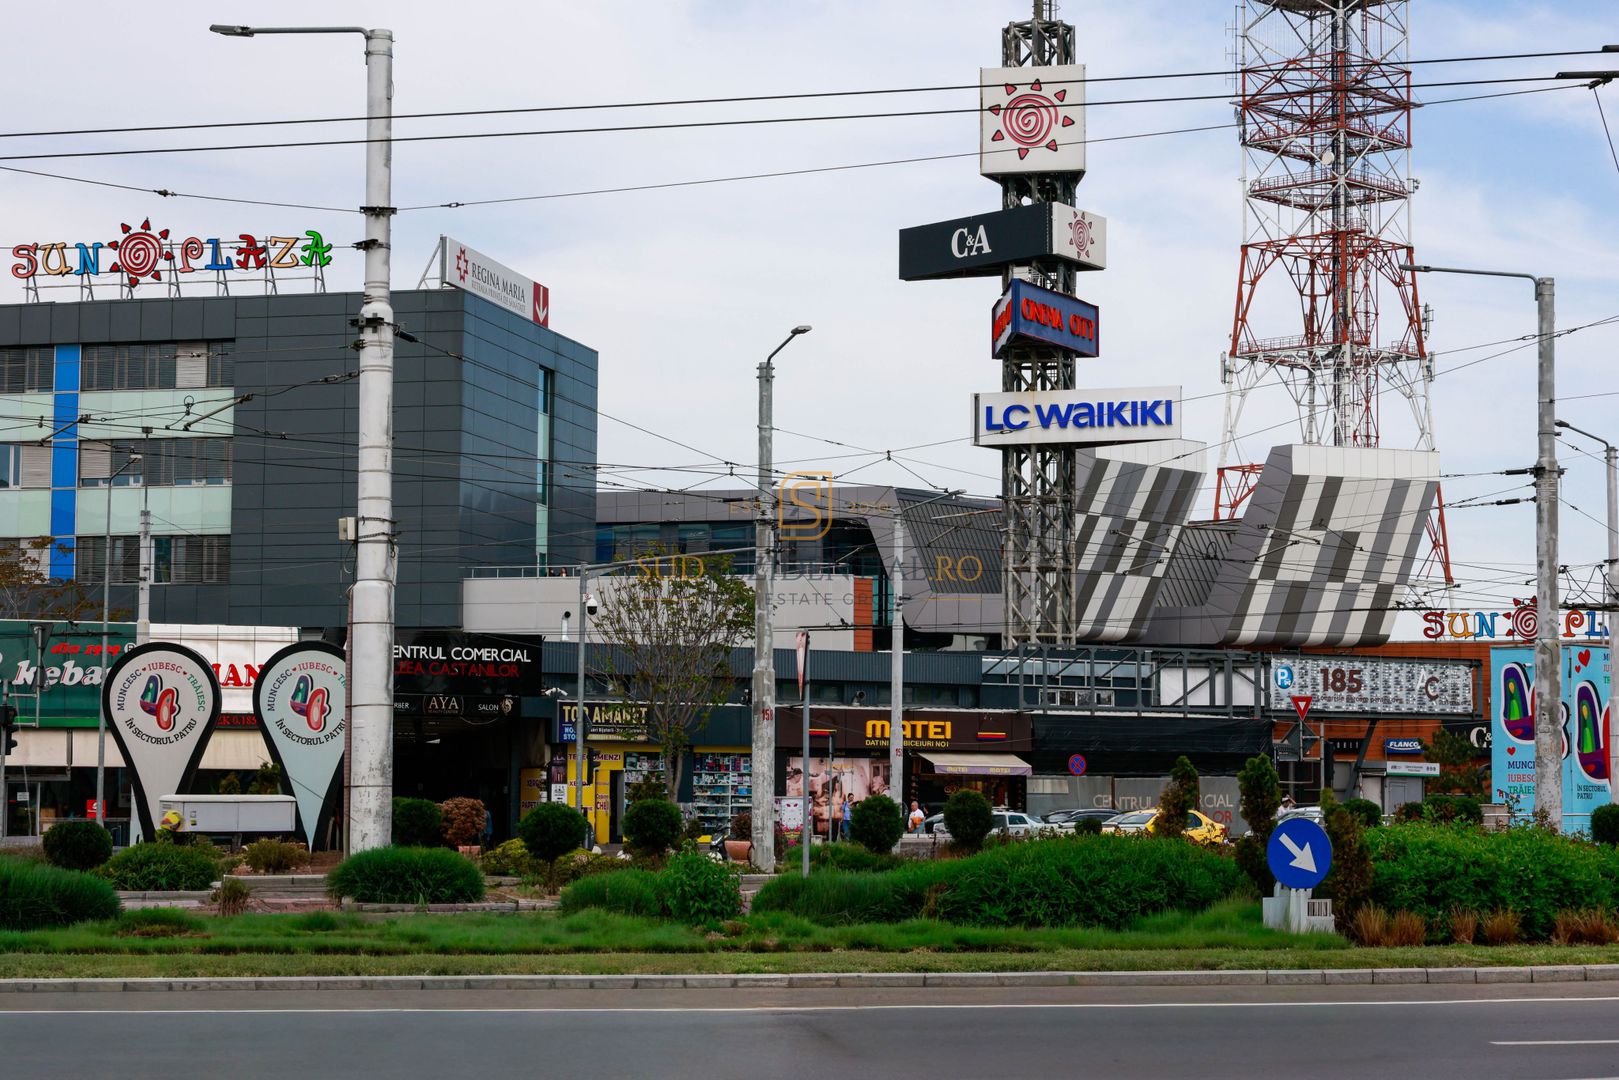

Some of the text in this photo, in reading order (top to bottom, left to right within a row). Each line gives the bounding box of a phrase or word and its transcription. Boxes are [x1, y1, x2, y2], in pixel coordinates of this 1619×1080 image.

[951, 225, 992, 258] C&A
[11, 230, 333, 279] SUN PLAZA
[471, 262, 500, 290] REGINA
[501, 278, 526, 303] MARIA
[1021, 298, 1064, 332] CINEMA
[1068, 314, 1096, 341] CITY
[985, 404, 1031, 431] LC
[1423, 610, 1499, 640] SUN
[394, 645, 531, 662] ENTRUL COMERCIAL
[117, 669, 142, 711] MUNCESC
[148, 662, 182, 674] IUBESC
[267, 662, 333, 712] MUNCESC IUBESC
[1320, 668, 1362, 693] 185
[428, 696, 459, 710] AYA
[592, 706, 647, 723] AMANT
[132, 727, 174, 745] SECTORUL
[173, 718, 197, 742] PATRU
[282, 728, 324, 746] SECTORUL
[866, 720, 951, 739] MATEI
[1470, 727, 1492, 748] C&
[1507, 760, 1536, 770] MUNC
[1508, 783, 1536, 795] TRĂIES
[1583, 785, 1606, 793] SECTORUL
[1198, 794, 1233, 808] RCIAL
